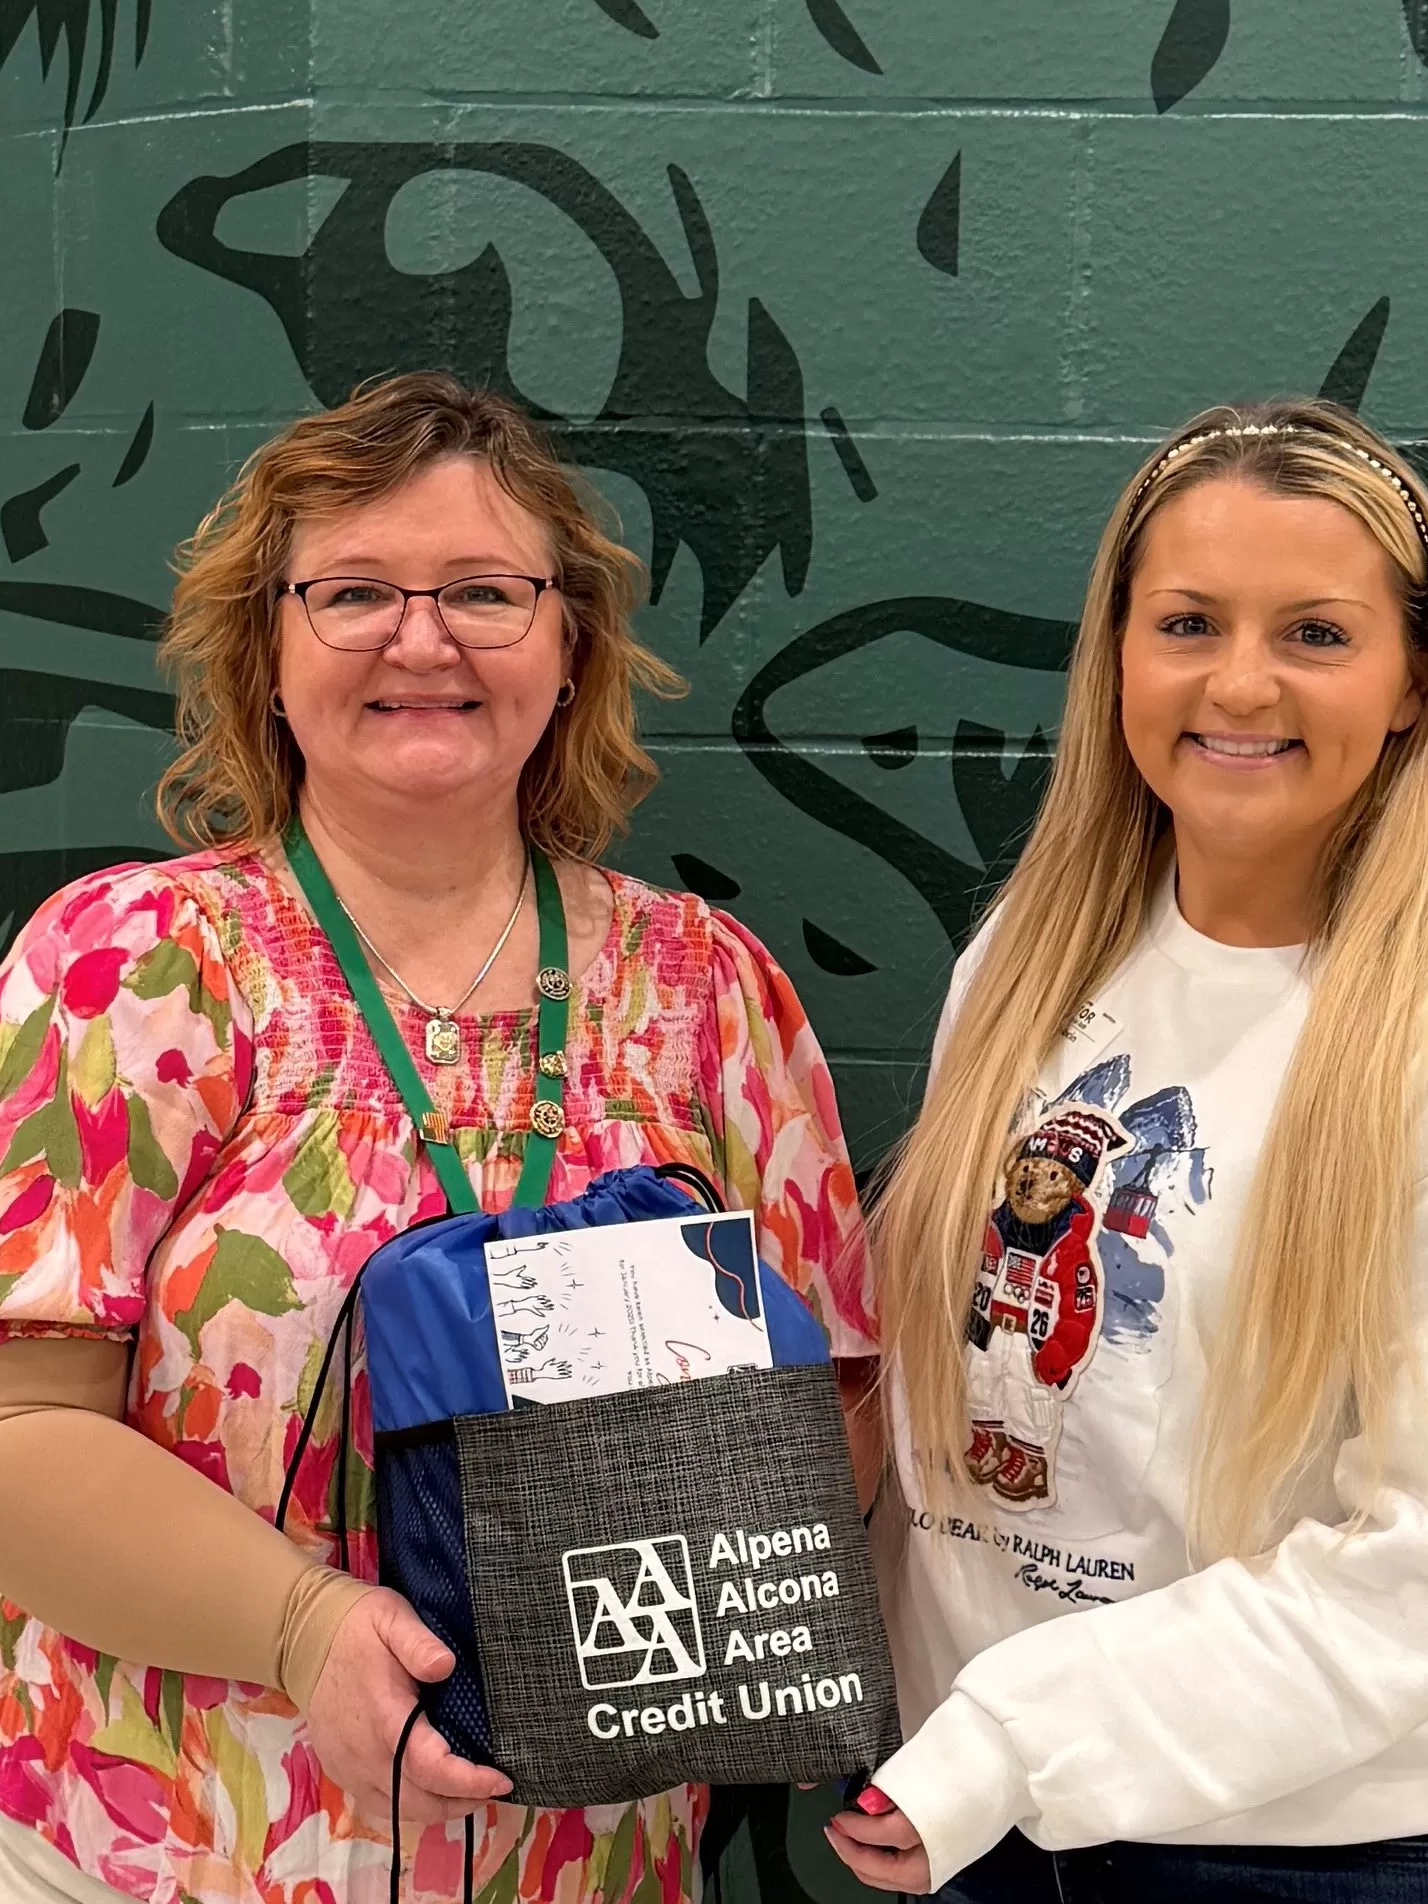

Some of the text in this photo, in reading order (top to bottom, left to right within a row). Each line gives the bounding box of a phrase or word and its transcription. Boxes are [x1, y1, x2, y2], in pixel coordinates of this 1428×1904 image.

[973, 1282, 1050, 1338] 20 26
[708, 1522, 832, 1570] Alpena
[1012, 1534, 1061, 1568] RALPH
[1066, 1553, 1136, 1581] LAUREN
[715, 1570, 840, 1618] Alcona
[723, 1624, 813, 1666] Area
[586, 1671, 864, 1740] Credit Union
